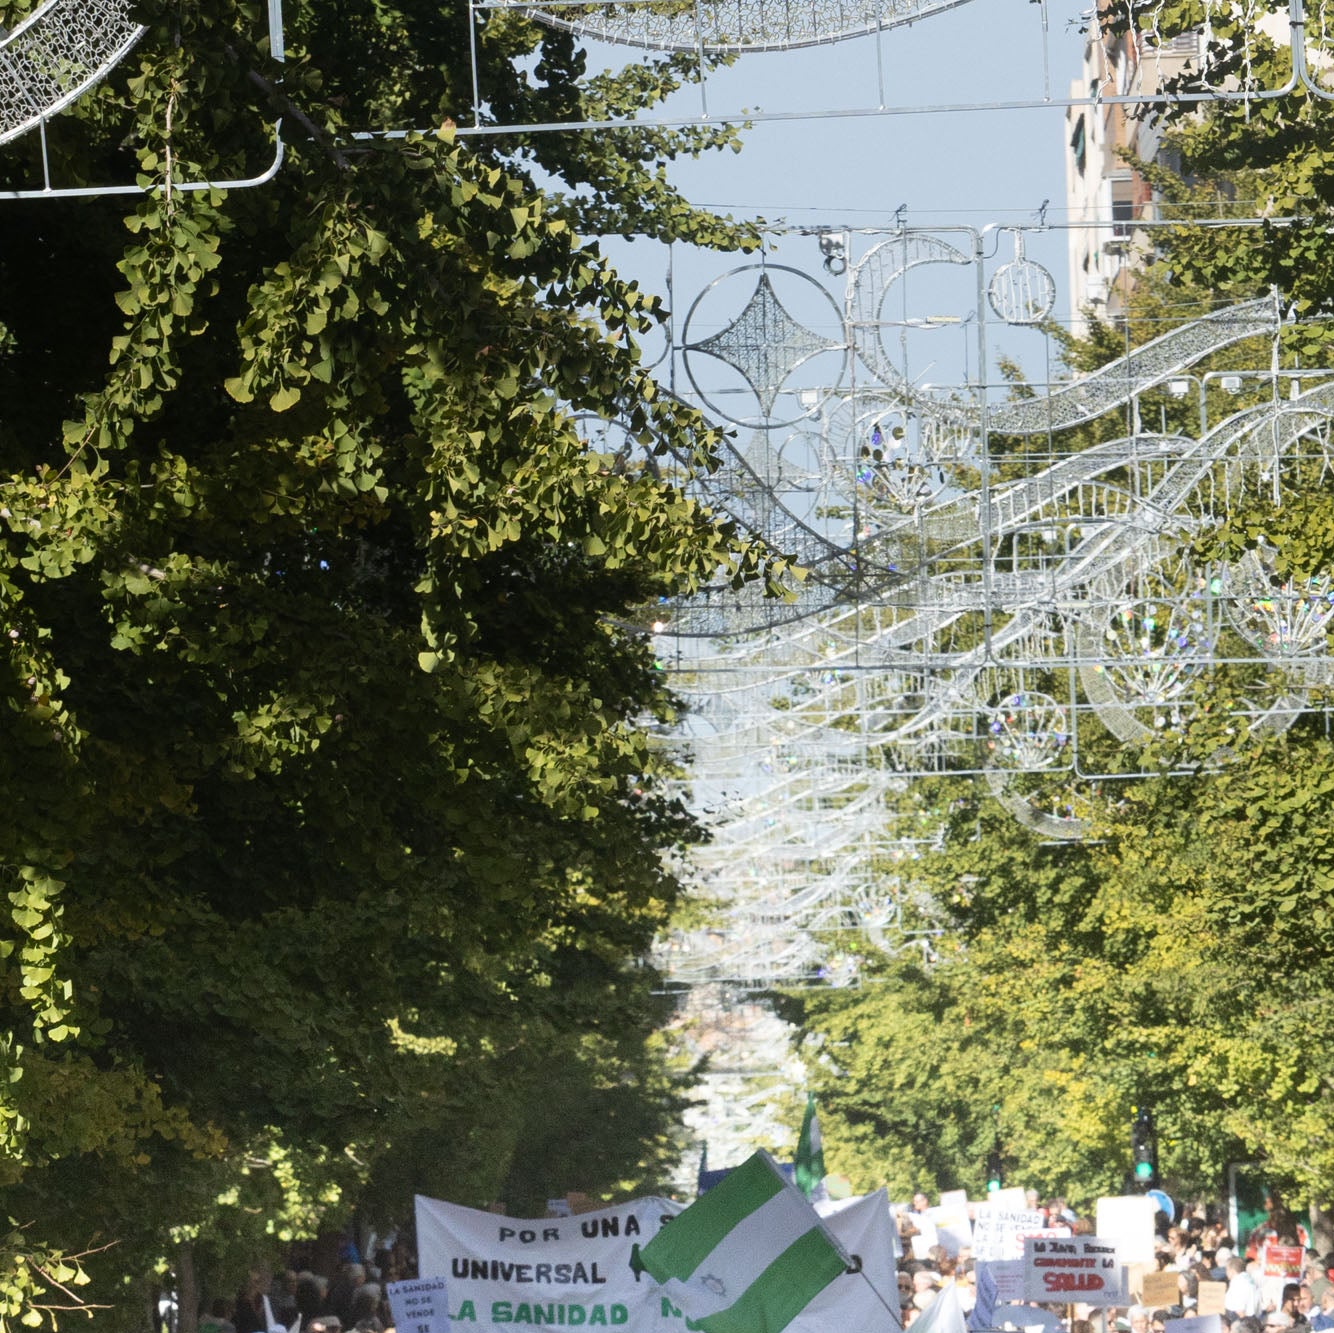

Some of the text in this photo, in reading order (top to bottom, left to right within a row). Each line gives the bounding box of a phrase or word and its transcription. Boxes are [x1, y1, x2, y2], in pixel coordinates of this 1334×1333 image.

[499, 1227, 560, 1244] POR
[580, 1215, 641, 1238] UNA
[452, 1258, 607, 1284] UNIVERSAL
[1043, 1271, 1105, 1292] SALUD
[402, 1282, 445, 1294] SANIDAD
[405, 1308, 435, 1319] VENDE
[491, 1301, 629, 1326] SANIDAD
[417, 1324, 430, 1333] SE
